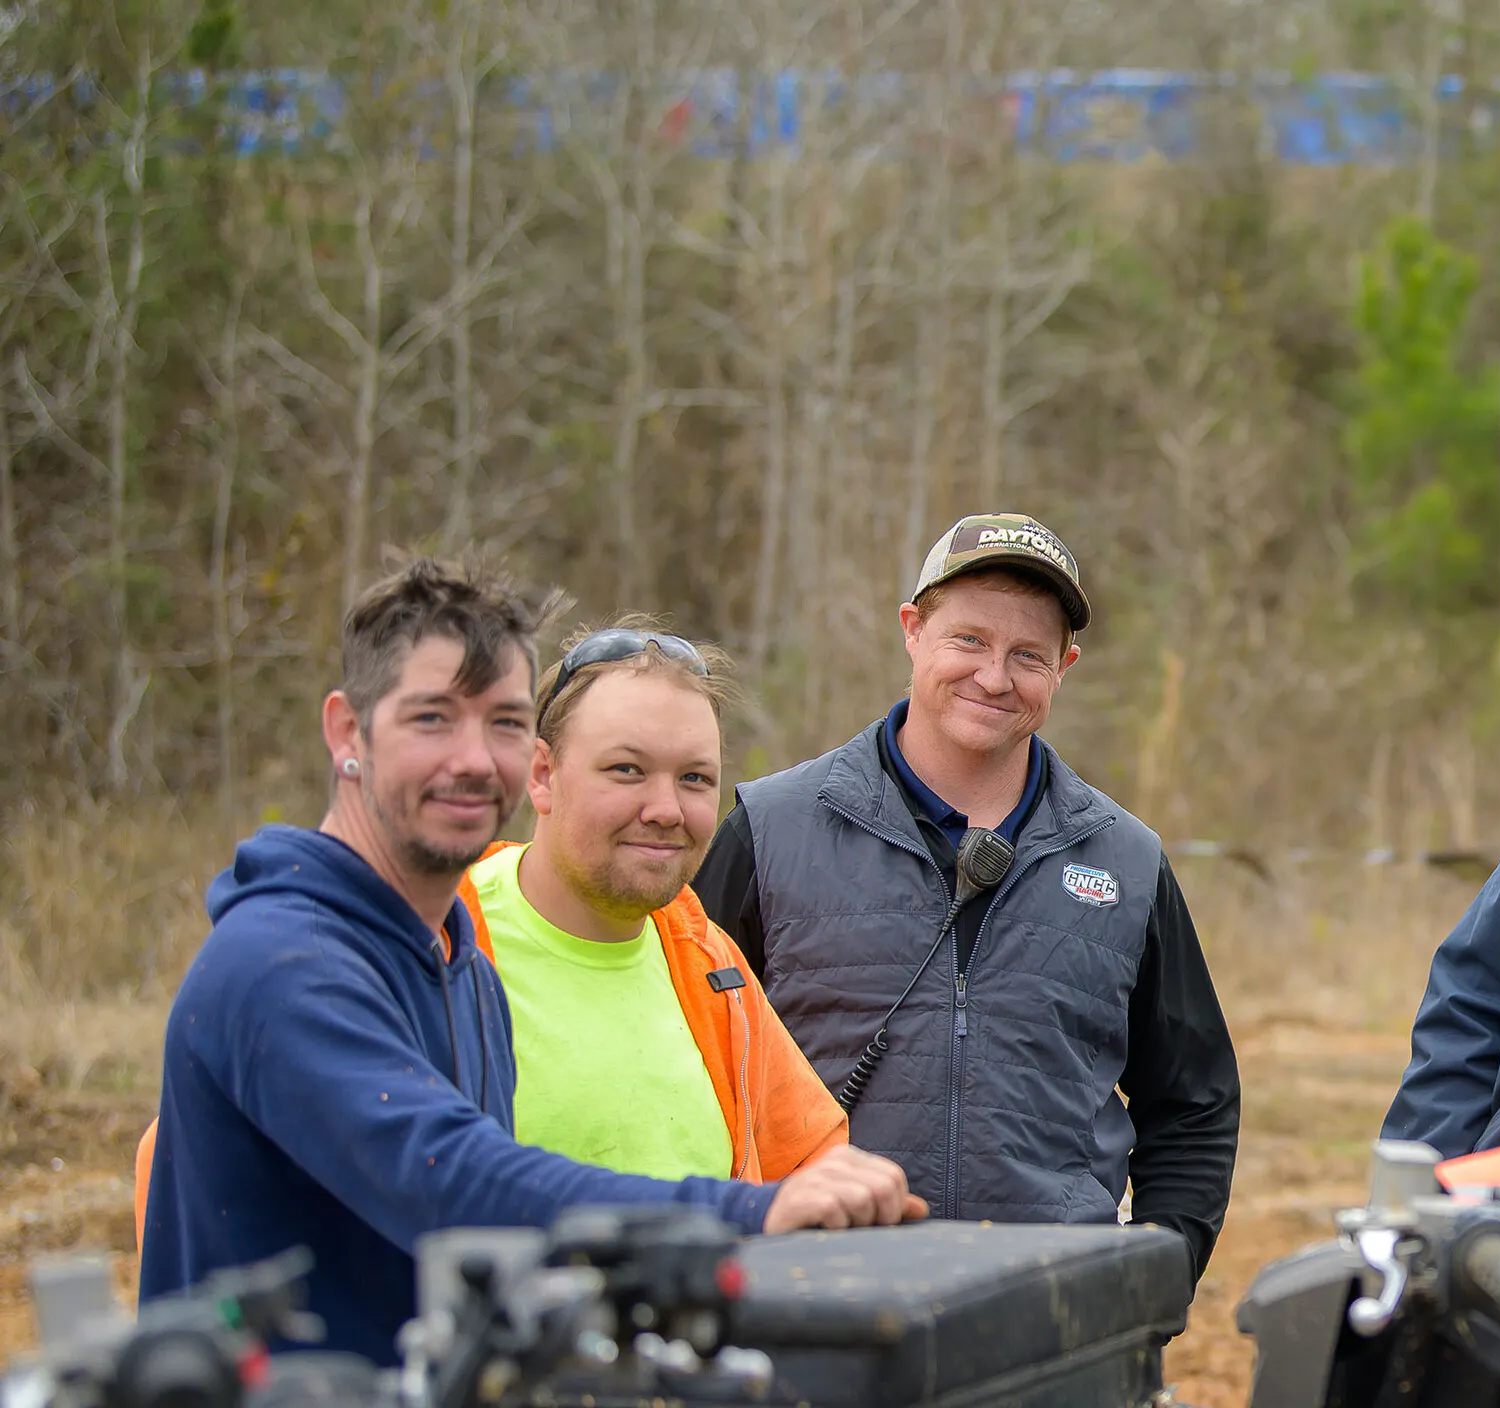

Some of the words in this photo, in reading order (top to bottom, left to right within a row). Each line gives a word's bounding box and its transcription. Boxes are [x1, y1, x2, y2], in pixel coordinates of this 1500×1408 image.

[976, 542, 1035, 552] INTERNATIONAL
[979, 529, 1067, 569] DAYTONA
[1064, 871, 1115, 895] GNCC
[1075, 887, 1104, 899] RACING
